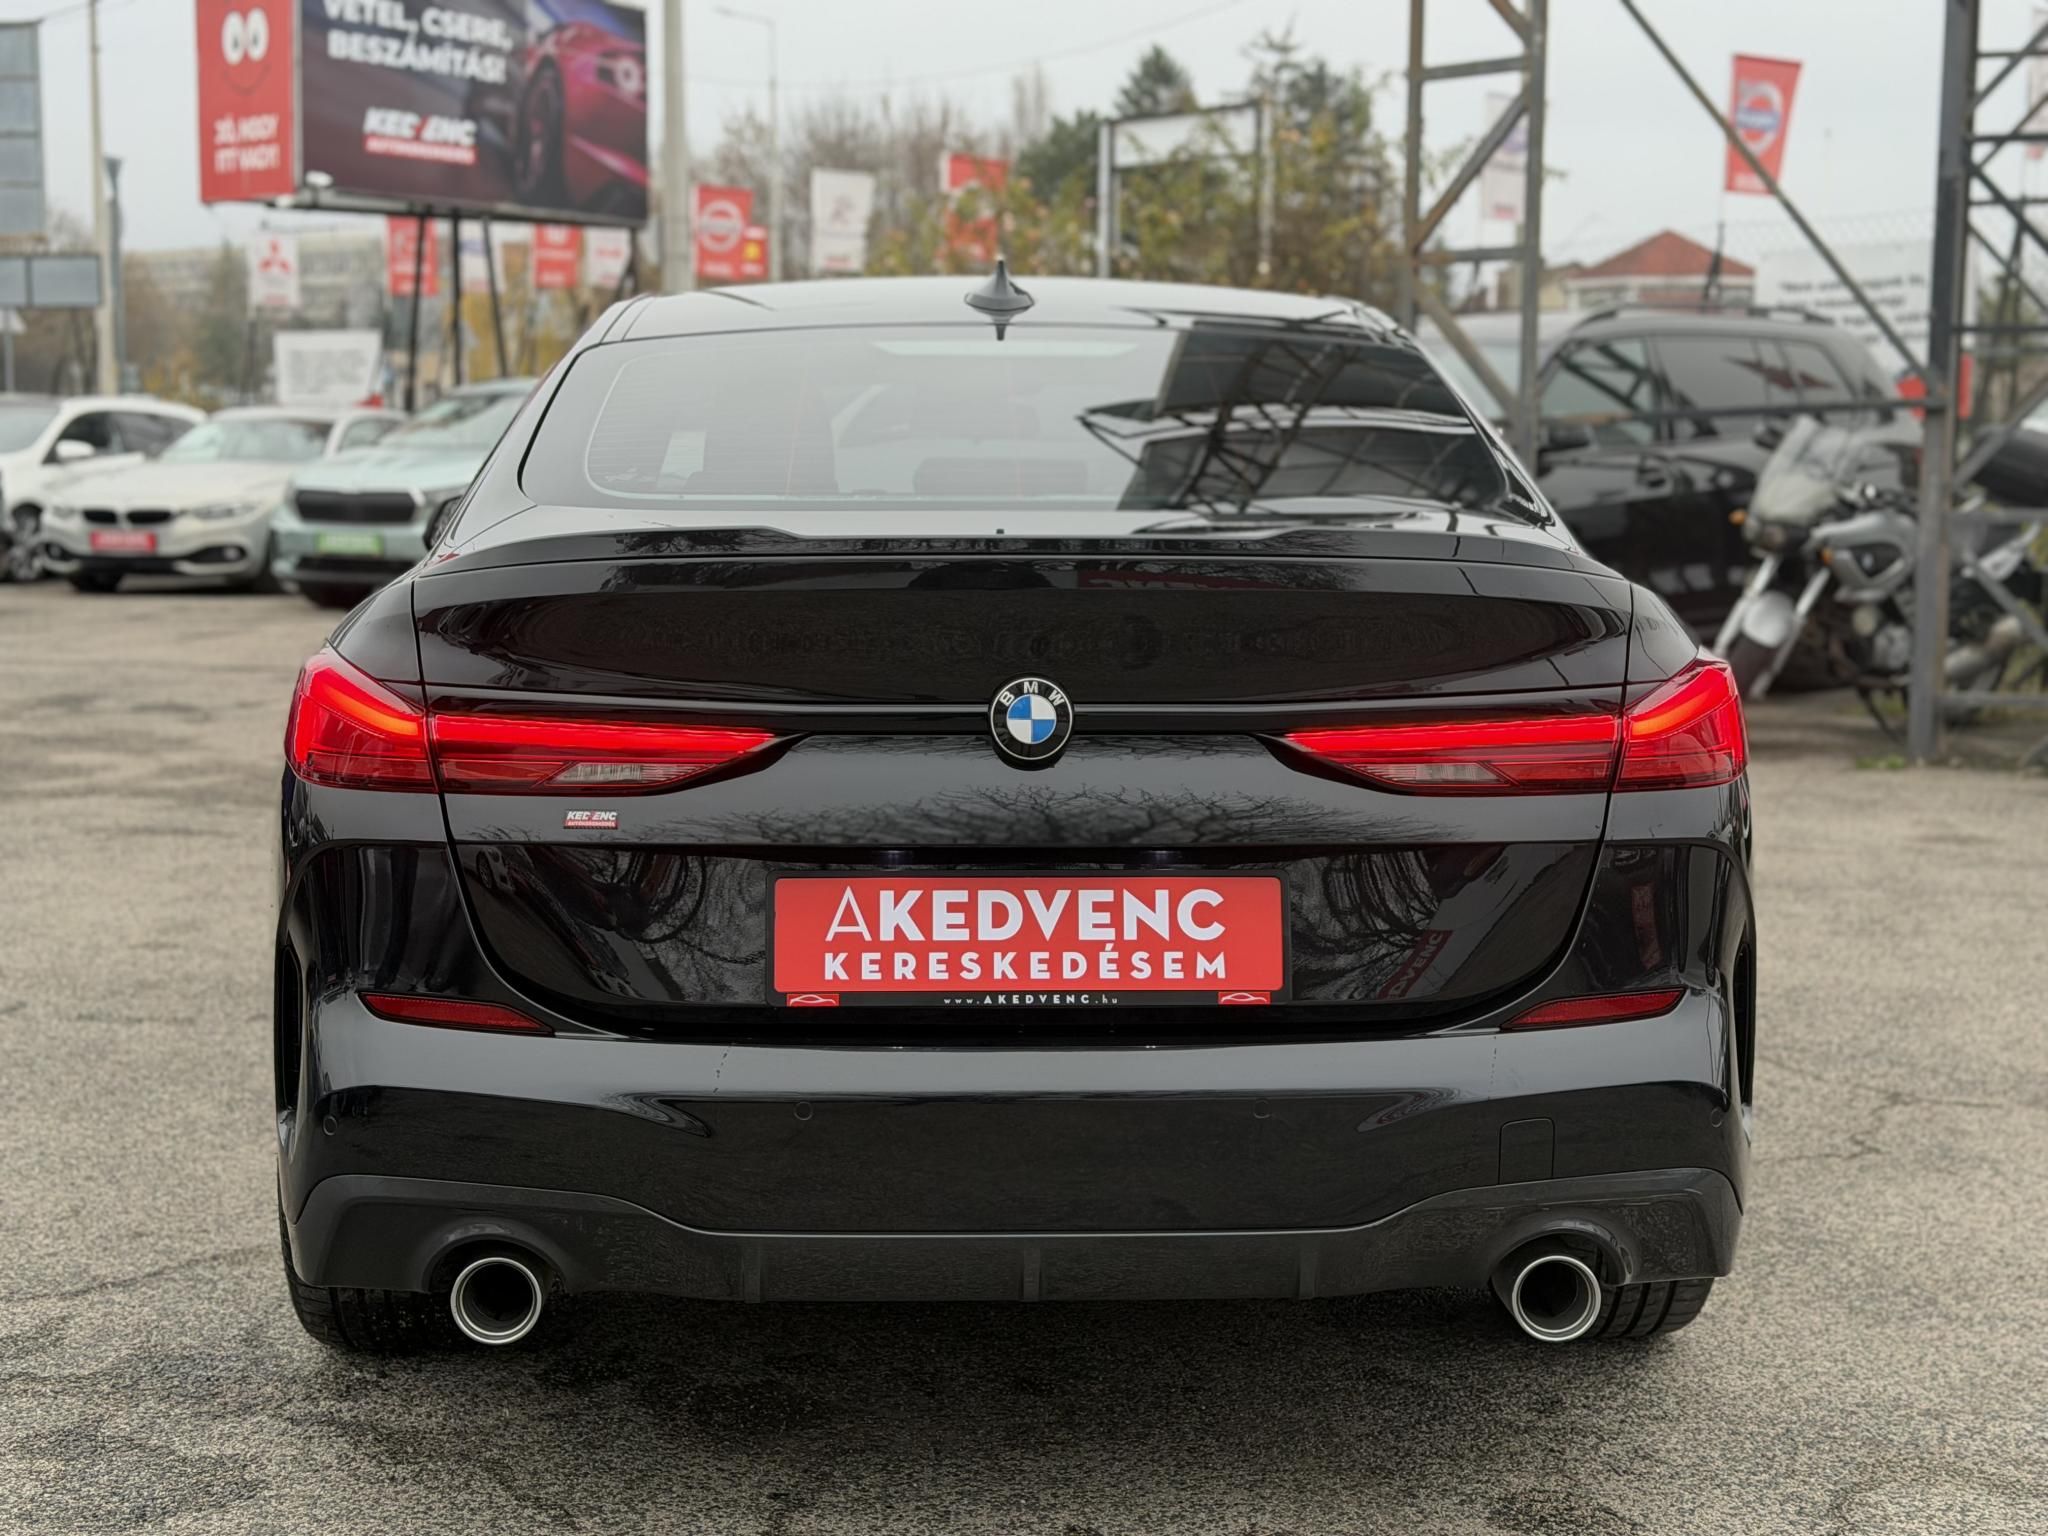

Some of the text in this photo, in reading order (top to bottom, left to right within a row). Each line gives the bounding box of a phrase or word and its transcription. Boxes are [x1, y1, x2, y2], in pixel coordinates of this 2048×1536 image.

[999, 681, 1064, 707] BMW
[825, 886, 1226, 942] AKEDVENC
[824, 944, 1226, 980] KERESKEDÉSEM
[943, 994, 1118, 1004] www.AKEDVENC.hu
